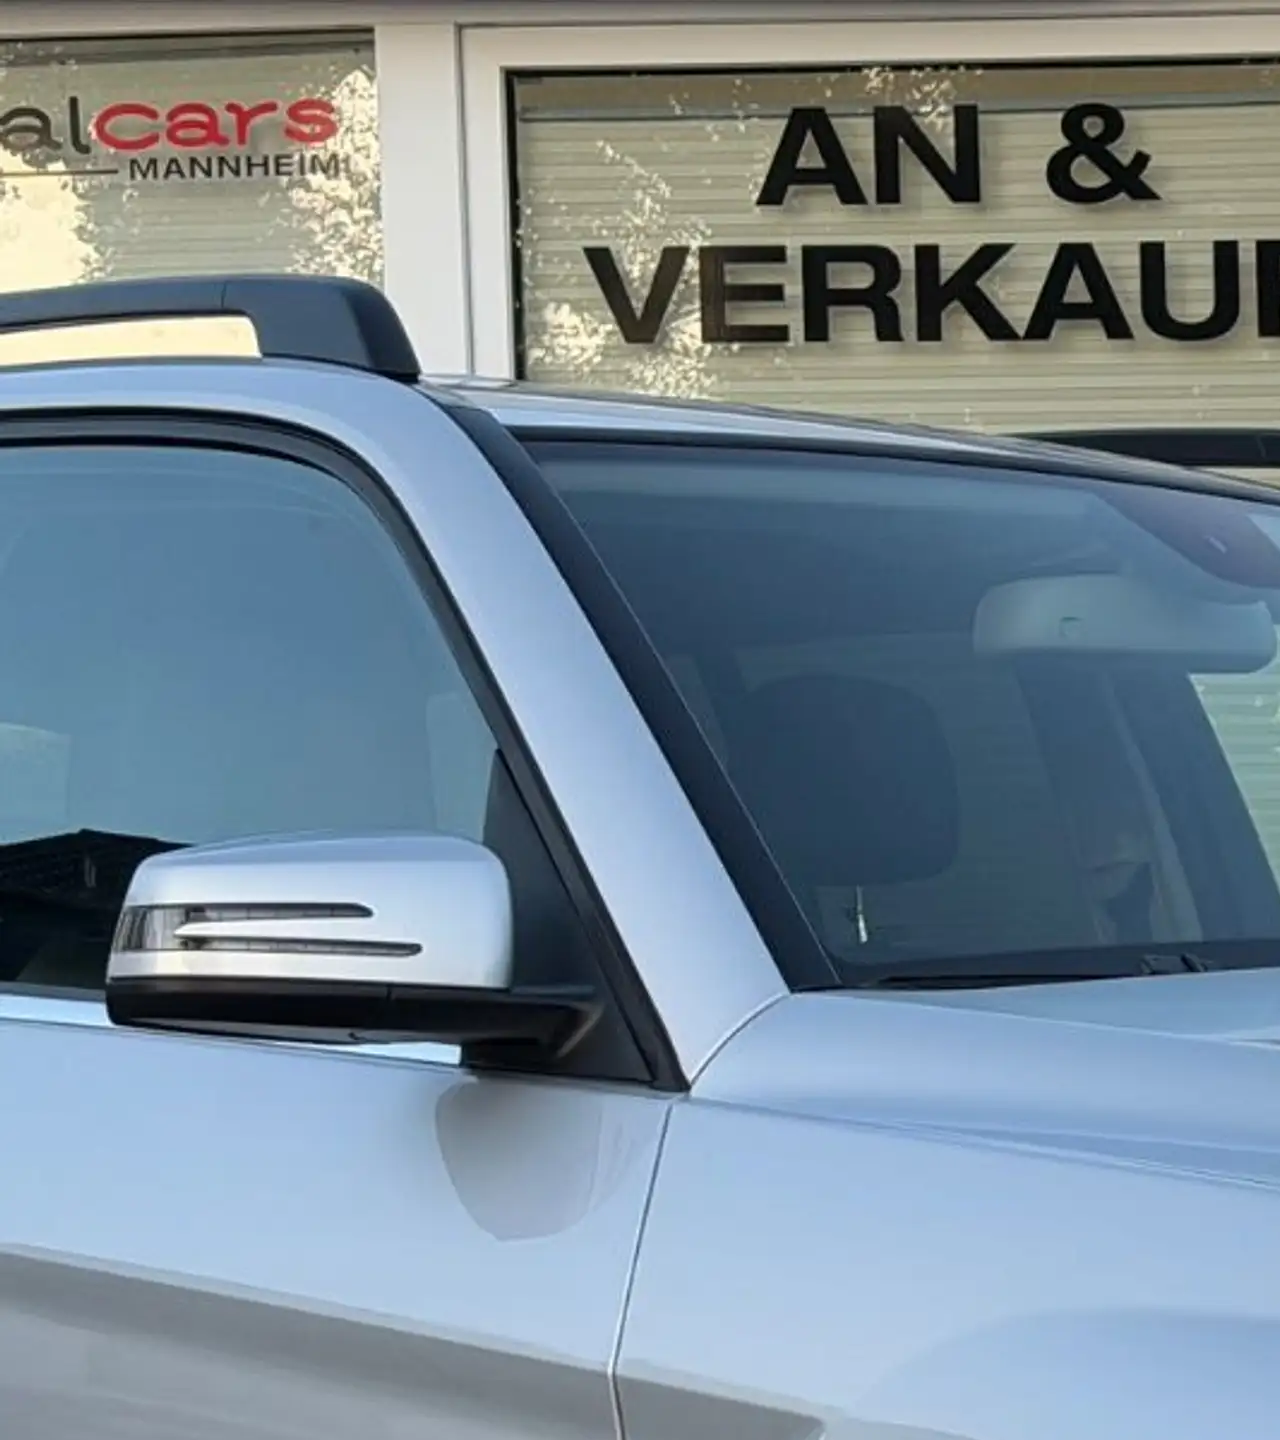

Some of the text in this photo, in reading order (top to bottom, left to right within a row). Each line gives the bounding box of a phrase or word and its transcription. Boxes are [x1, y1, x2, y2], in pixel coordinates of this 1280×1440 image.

[129, 154, 340, 181] MANNHEIM
[756, 102, 1162, 206] AN &
